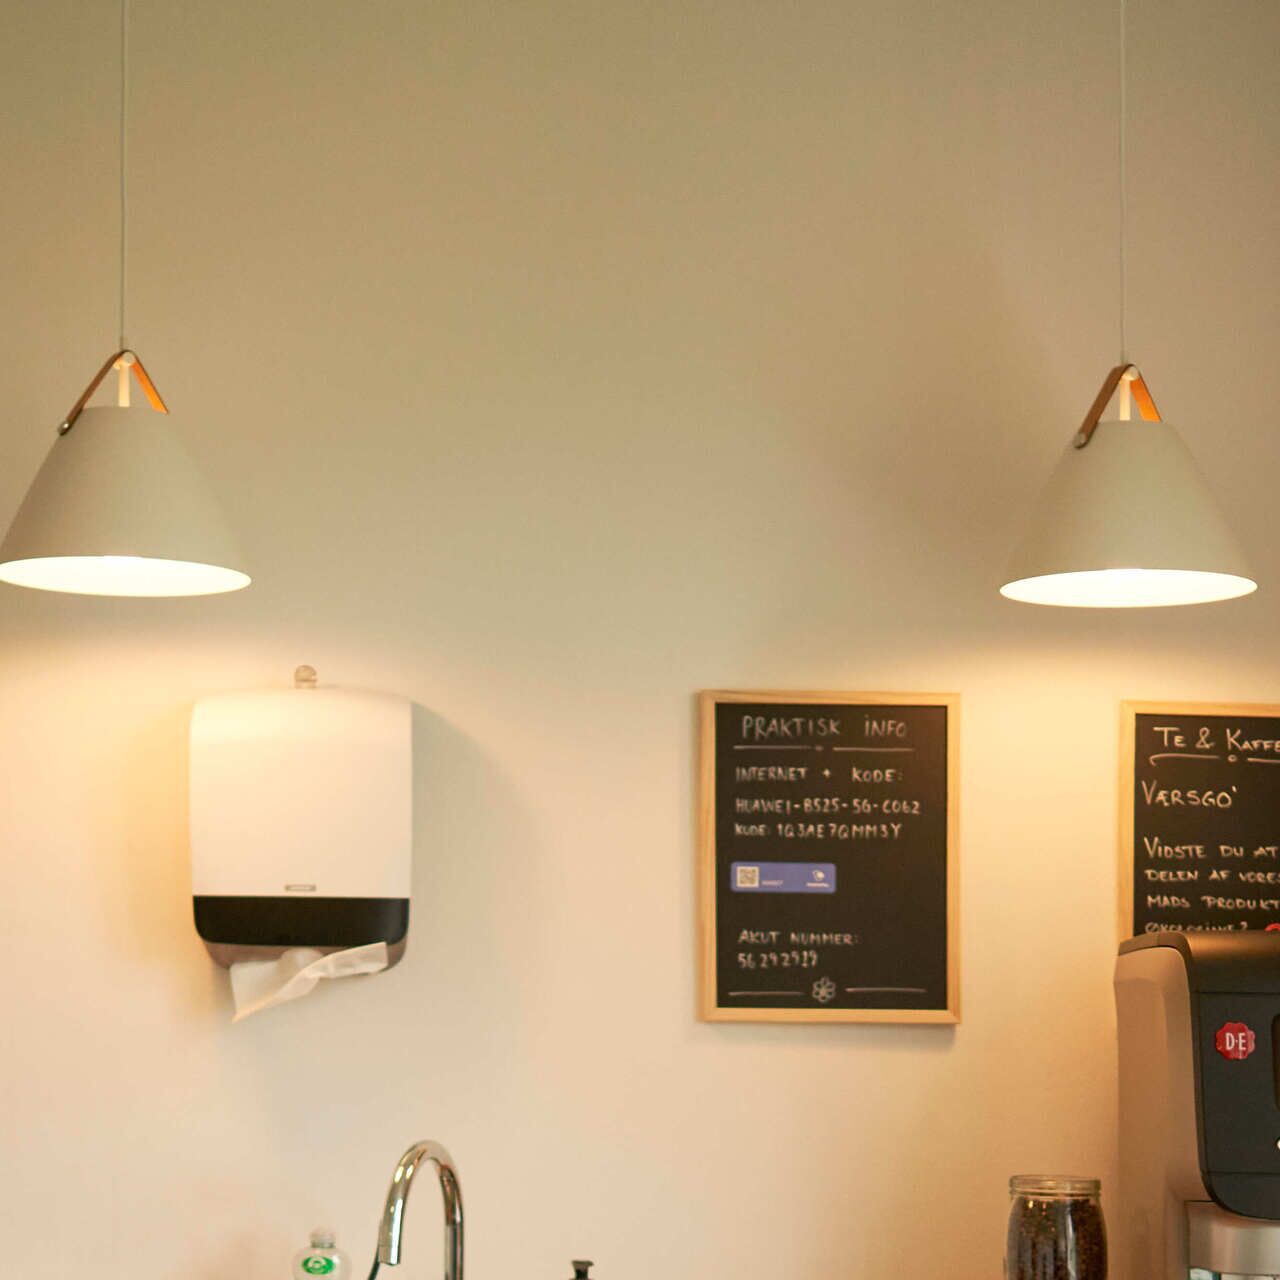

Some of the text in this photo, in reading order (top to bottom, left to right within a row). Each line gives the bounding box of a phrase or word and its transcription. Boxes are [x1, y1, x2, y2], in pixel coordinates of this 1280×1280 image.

[742, 715, 841, 740] PRAKTISK
[1195, 727, 1215, 749] &
[736, 766, 808, 783] INTERNET
[1219, 844, 1244, 858] DU
[1253, 846, 1279, 858] AT
[1144, 869, 1199, 883] DELEN
[1208, 869, 1231, 881] AF
[1147, 895, 1191, 909] MADS
[738, 929, 780, 945] AKUT
